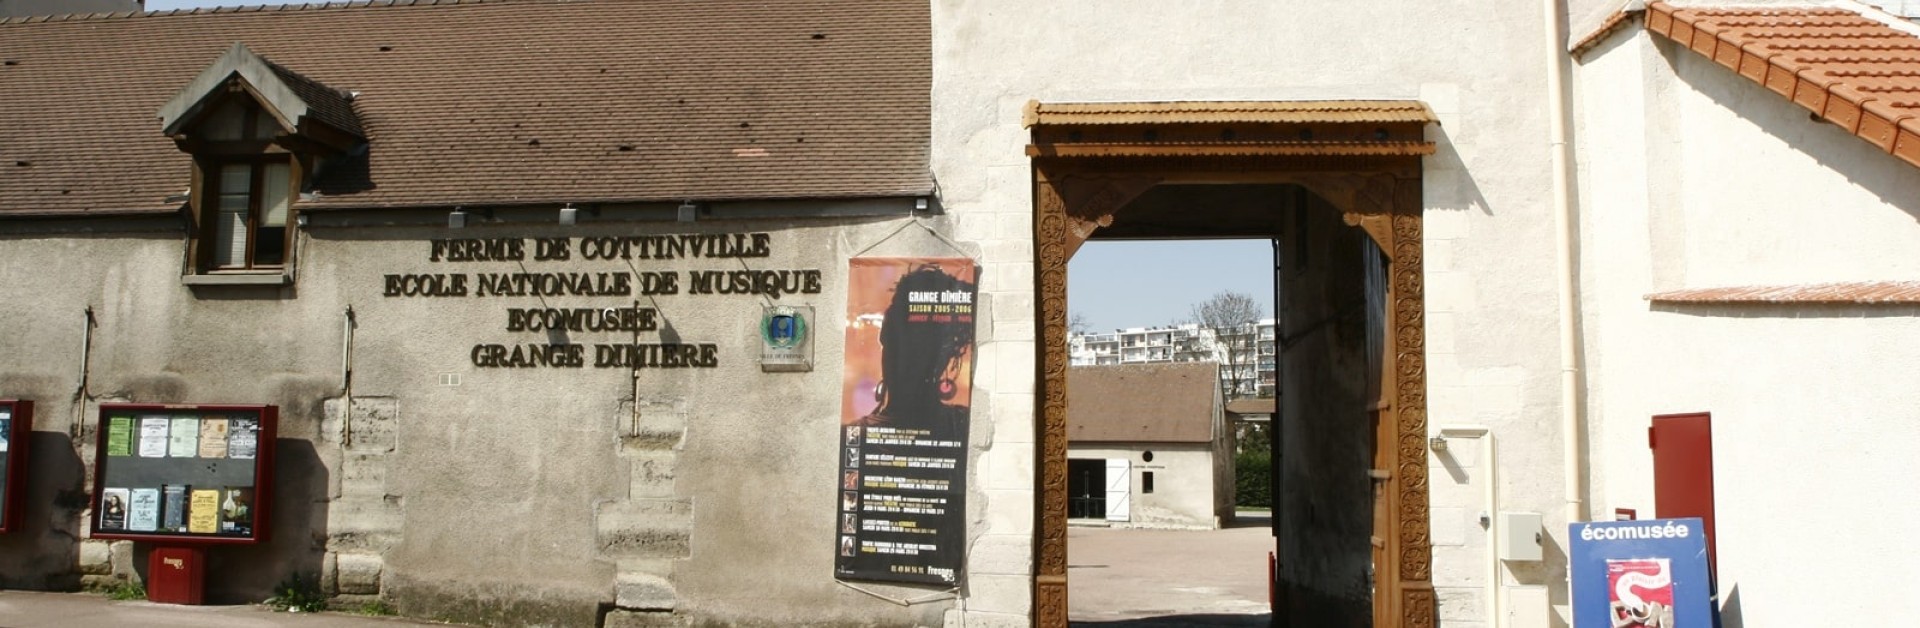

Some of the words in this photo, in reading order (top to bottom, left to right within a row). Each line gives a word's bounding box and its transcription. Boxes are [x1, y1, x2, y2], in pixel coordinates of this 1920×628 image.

[430, 237, 525, 262] FERME
[534, 237, 570, 261] DE
[580, 233, 770, 260] COTTINVILLE
[383, 273, 468, 297] ECOLE
[476, 271, 631, 297] NATIONALE
[641, 271, 679, 296] DE
[689, 269, 822, 299] MUSIQUE
[908, 291, 939, 304] GRANGE
[941, 289, 972, 304] DÎMIÈRE
[506, 308, 657, 331] ECOMUSEE
[908, 304, 931, 313] SAISON
[471, 344, 584, 367] GRANGE
[594, 343, 718, 368] DIMIERE
[1581, 521, 1689, 541] écomusée
